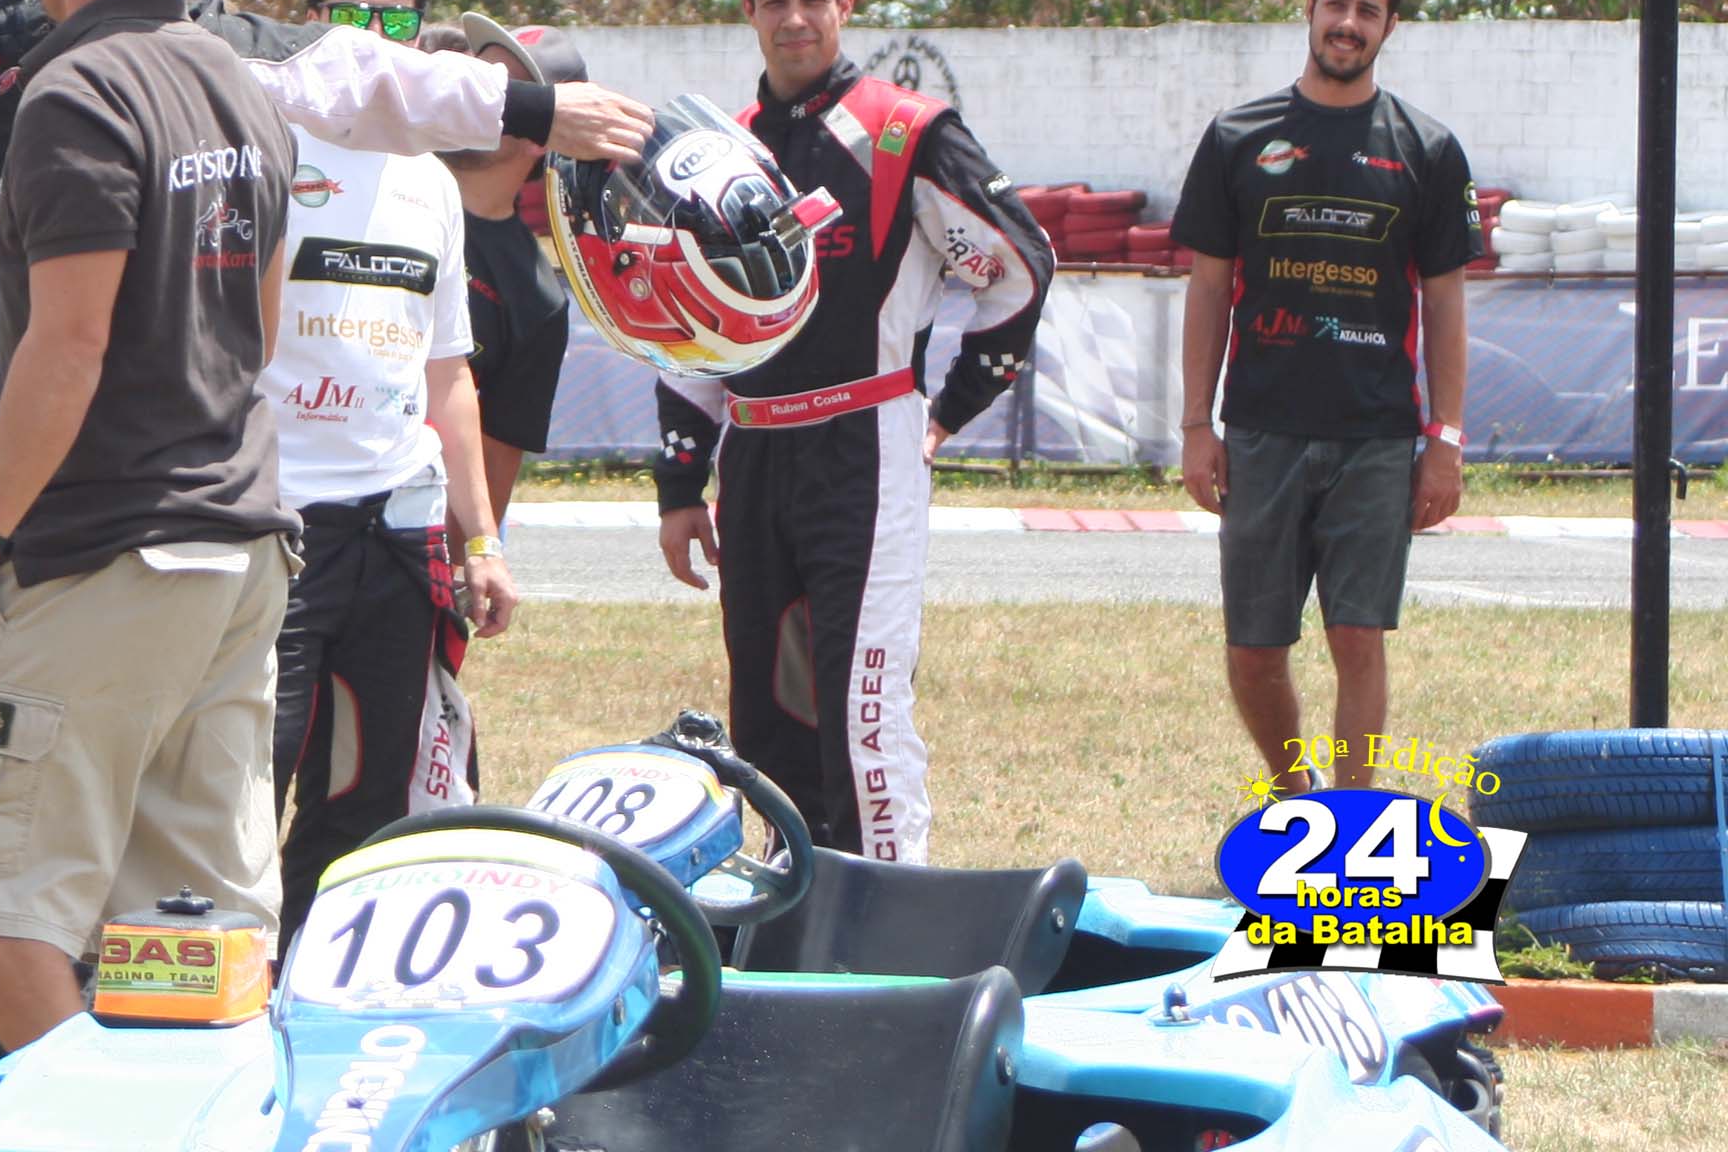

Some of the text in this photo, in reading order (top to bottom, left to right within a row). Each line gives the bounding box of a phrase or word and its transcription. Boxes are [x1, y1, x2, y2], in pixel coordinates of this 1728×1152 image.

[283, 376, 357, 410] AJM
[771, 391, 851, 416] Ruben Costa
[426, 721, 451, 800] ACES
[860, 647, 897, 862] CING ACES
[537, 777, 656, 836] 108
[328, 886, 561, 989] 103
[170, 972, 215, 985] TEAM
